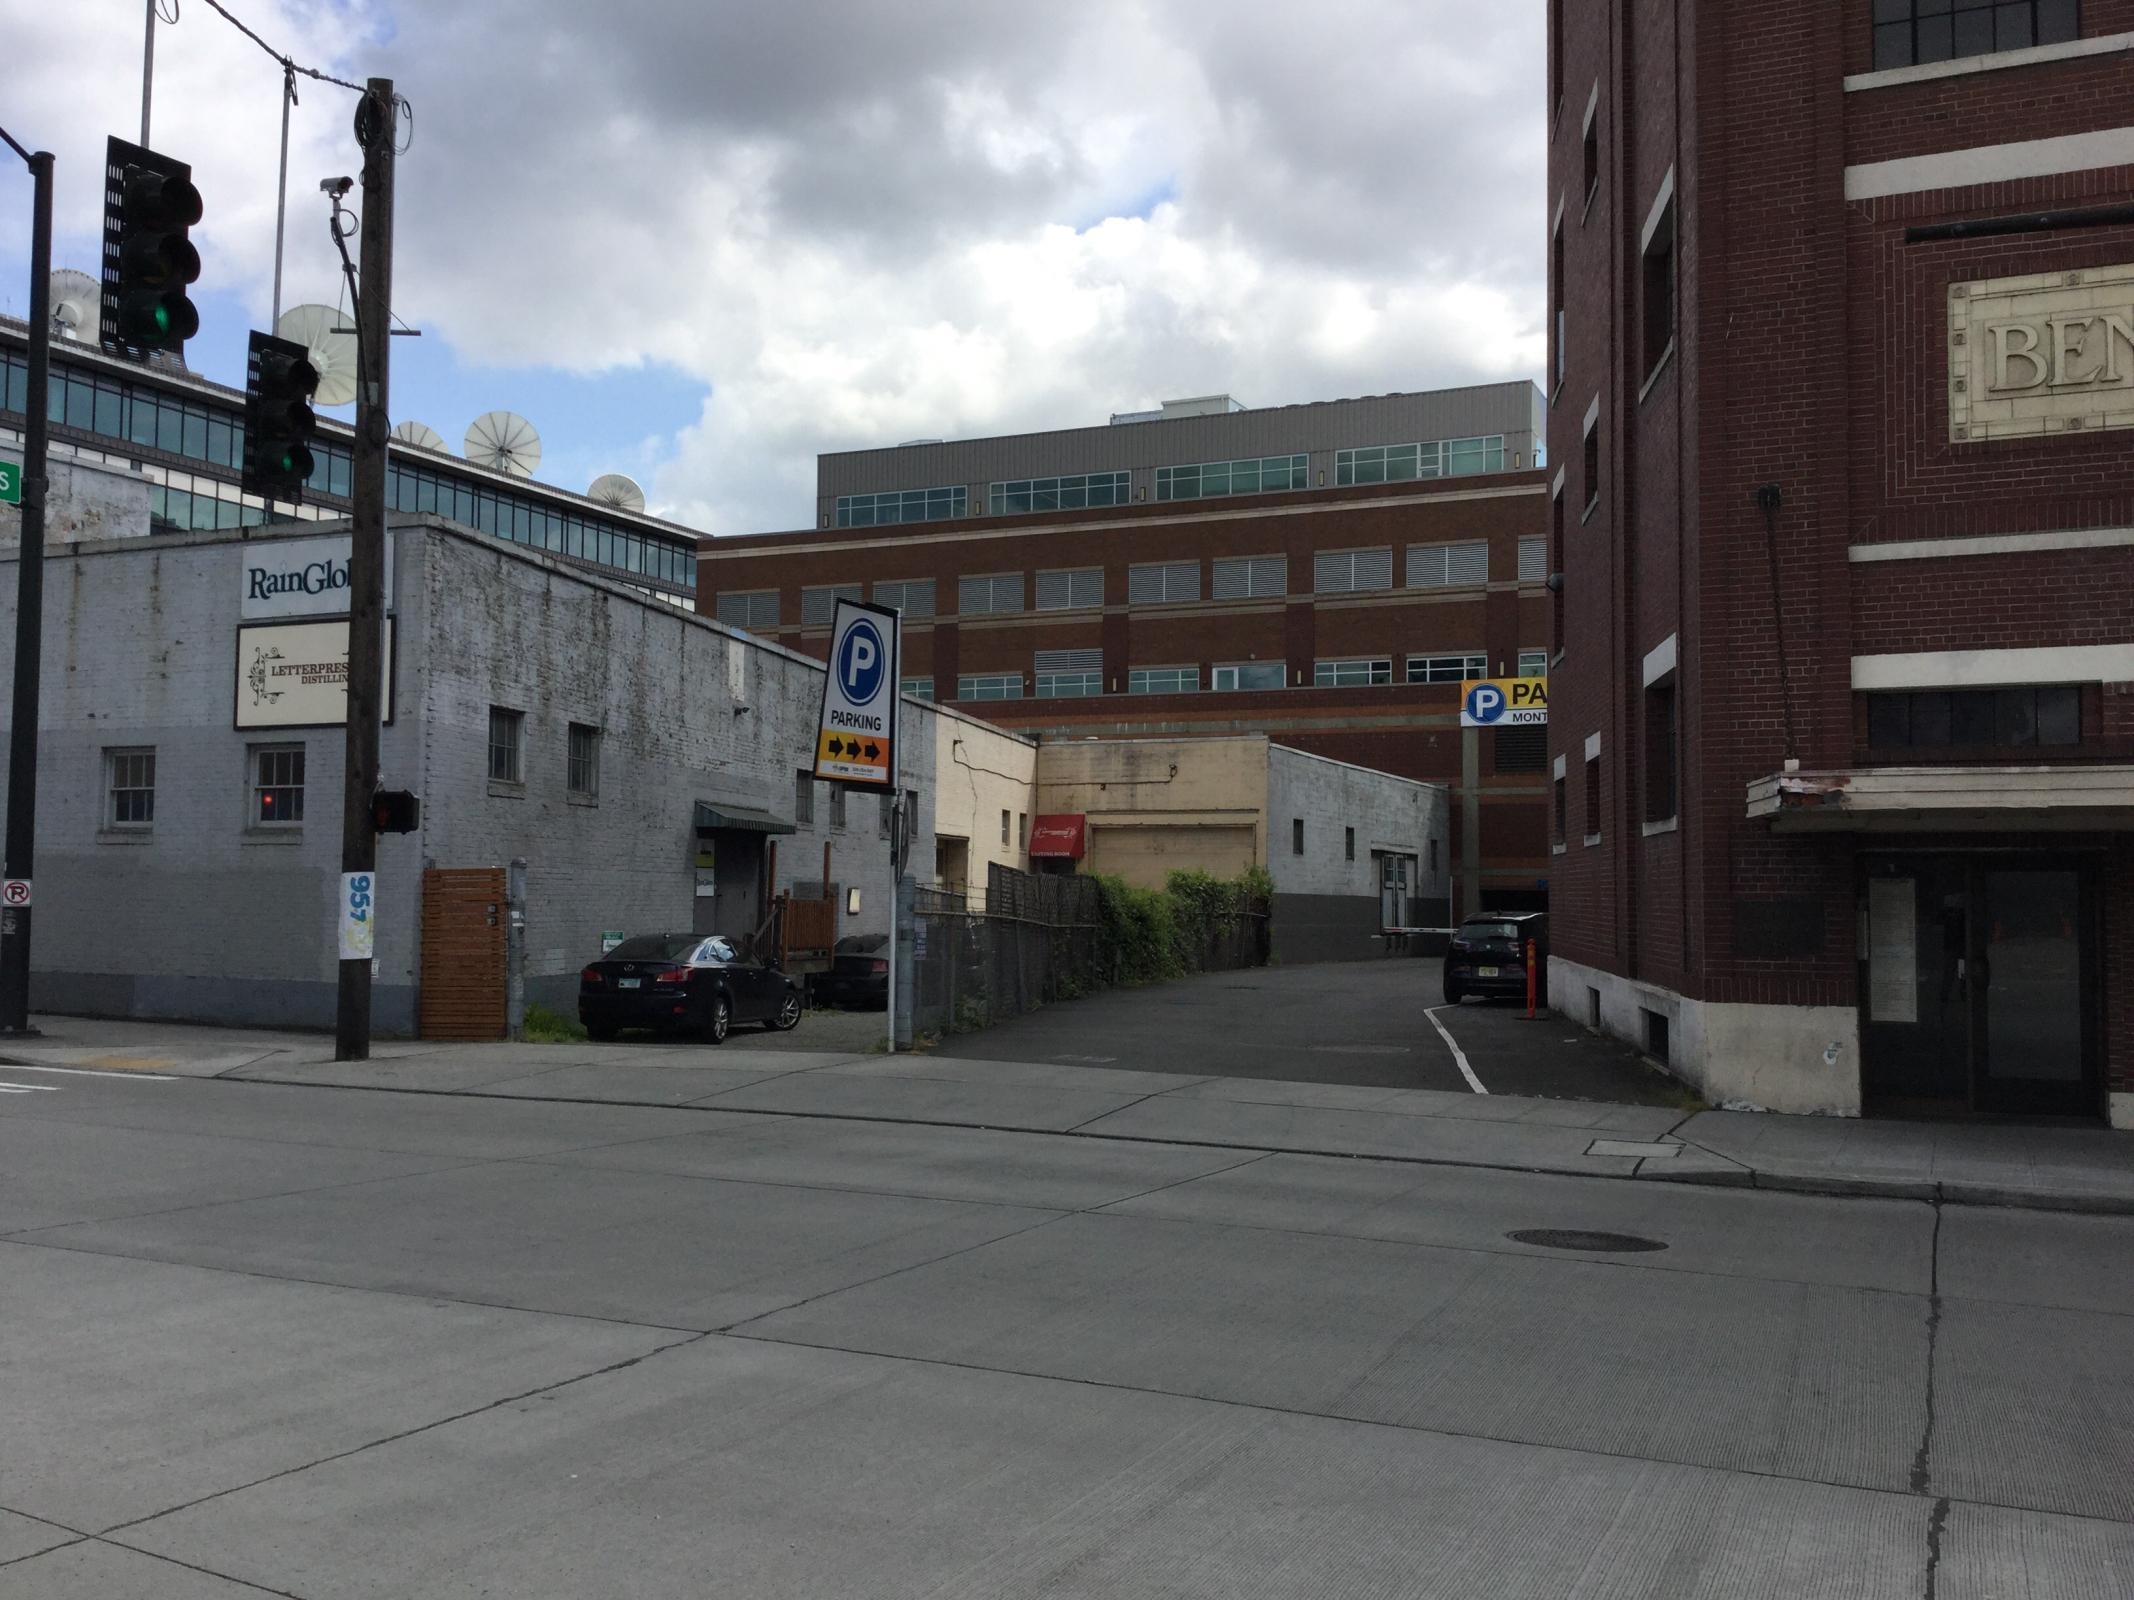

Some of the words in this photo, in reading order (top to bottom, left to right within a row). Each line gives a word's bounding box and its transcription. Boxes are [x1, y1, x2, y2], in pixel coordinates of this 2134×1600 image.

[848, 635, 876, 687] P
[1476, 689, 1500, 718] P
[830, 709, 882, 732] PARKING
